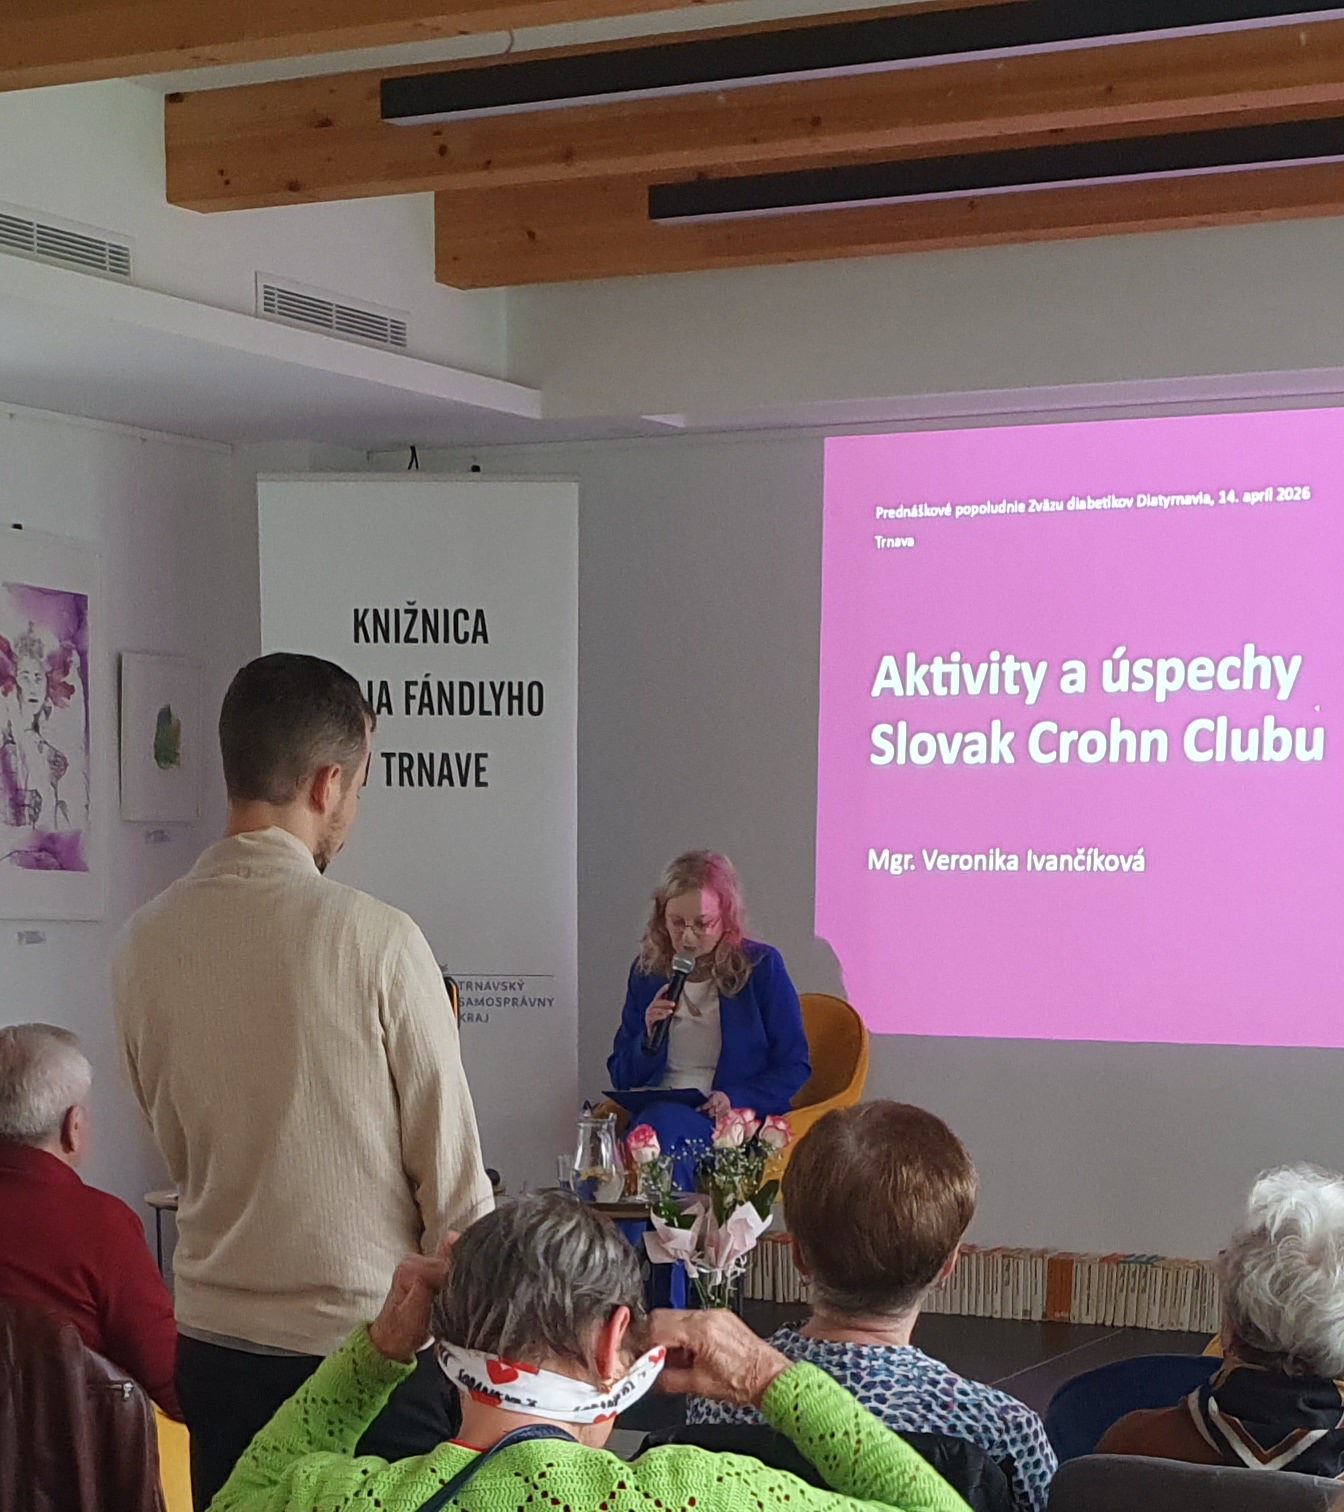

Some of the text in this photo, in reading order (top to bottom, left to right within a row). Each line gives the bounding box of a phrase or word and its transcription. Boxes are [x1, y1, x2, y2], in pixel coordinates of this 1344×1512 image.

[875, 502, 952, 519] Prednáškové
[955, 499, 1026, 519] popoludnie
[1066, 494, 1134, 511] diabetikov
[1136, 491, 1215, 510] Diatyrnavia,
[1218, 488, 1239, 504] 14.
[1276, 486, 1311, 502] 2026
[874, 535, 915, 549] Trnava
[353, 600, 489, 644] KNIŽNICA
[871, 643, 1303, 706] Aktivity a úspechy
[404, 672, 544, 716] FÁNDLYHO
[870, 713, 1325, 767] Slovak Crohn Clubu
[380, 752, 489, 788] TRNAVE
[868, 846, 1145, 875] Mgr. Veronika Ivančíková
[459, 979, 525, 992] TRNAVSKÝ
[459, 1012, 490, 1024] KRAJ
